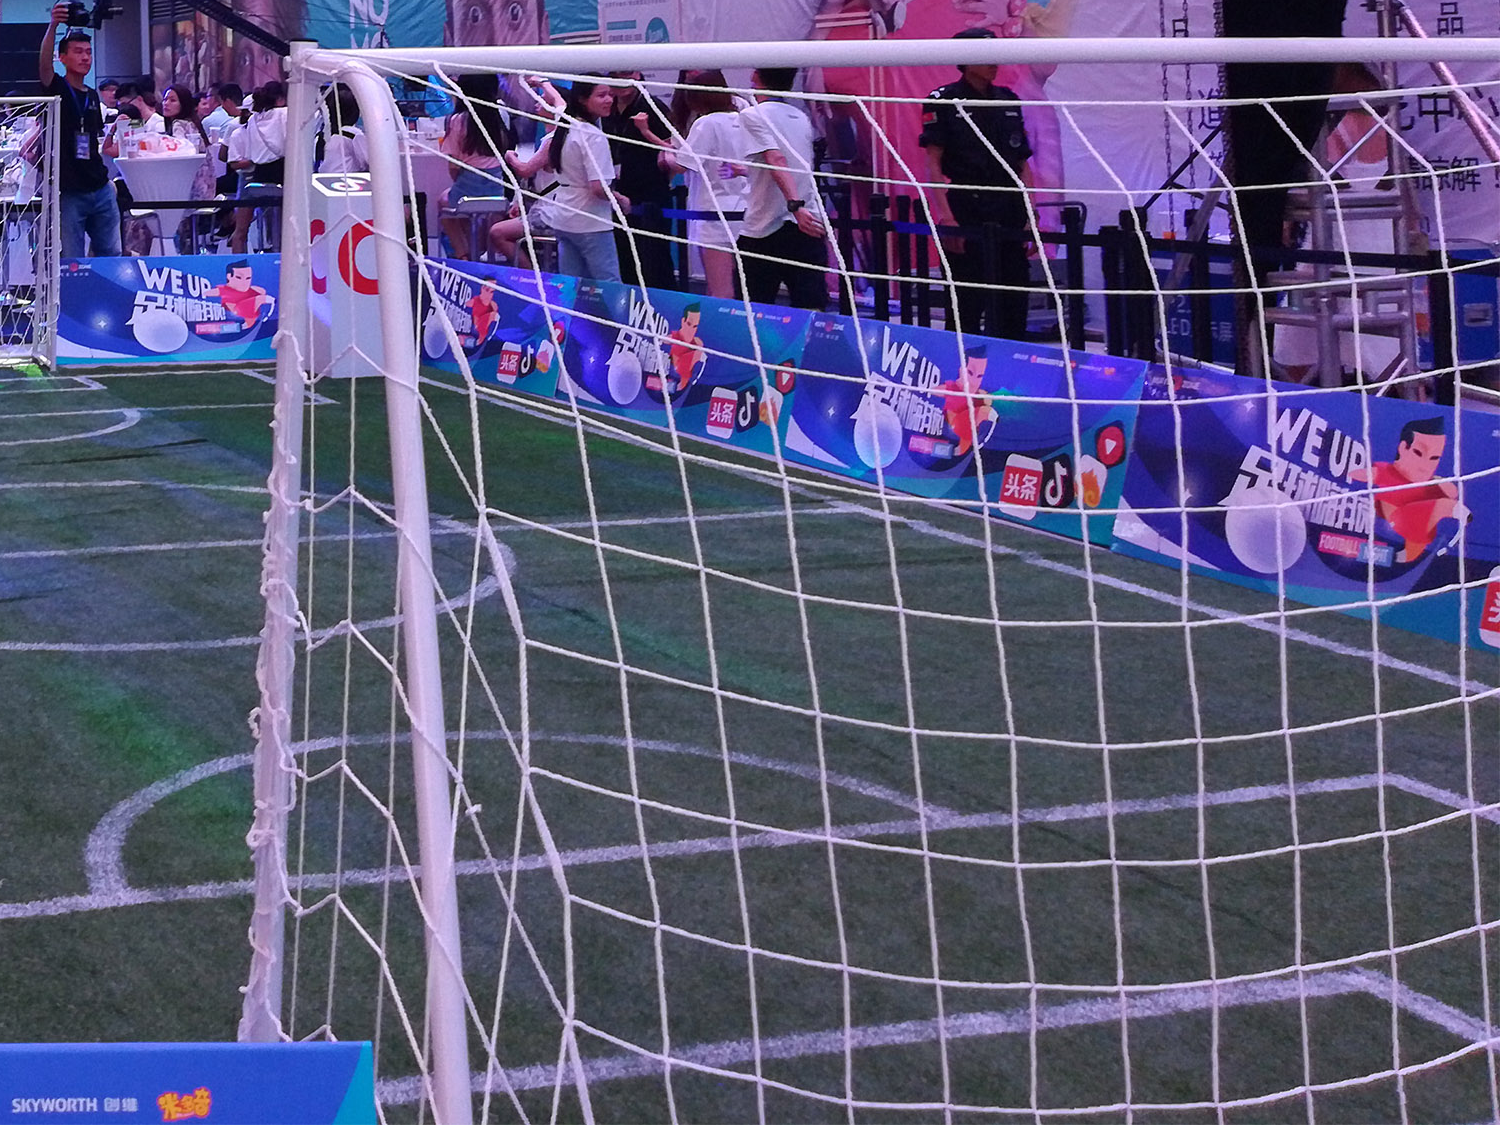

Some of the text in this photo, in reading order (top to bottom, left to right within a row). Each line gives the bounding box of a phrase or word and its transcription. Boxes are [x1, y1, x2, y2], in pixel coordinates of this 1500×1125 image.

[137, 259, 211, 299] WE UP
[439, 261, 460, 302] WE
[881, 326, 941, 398] WE UP
[709, 403, 735, 424] 头条
[1268, 400, 1370, 483] WE UP
[1004, 473, 1038, 502] 头条
[11, 1097, 98, 1113] SKYWORTH
[104, 1097, 138, 1113] 创维
